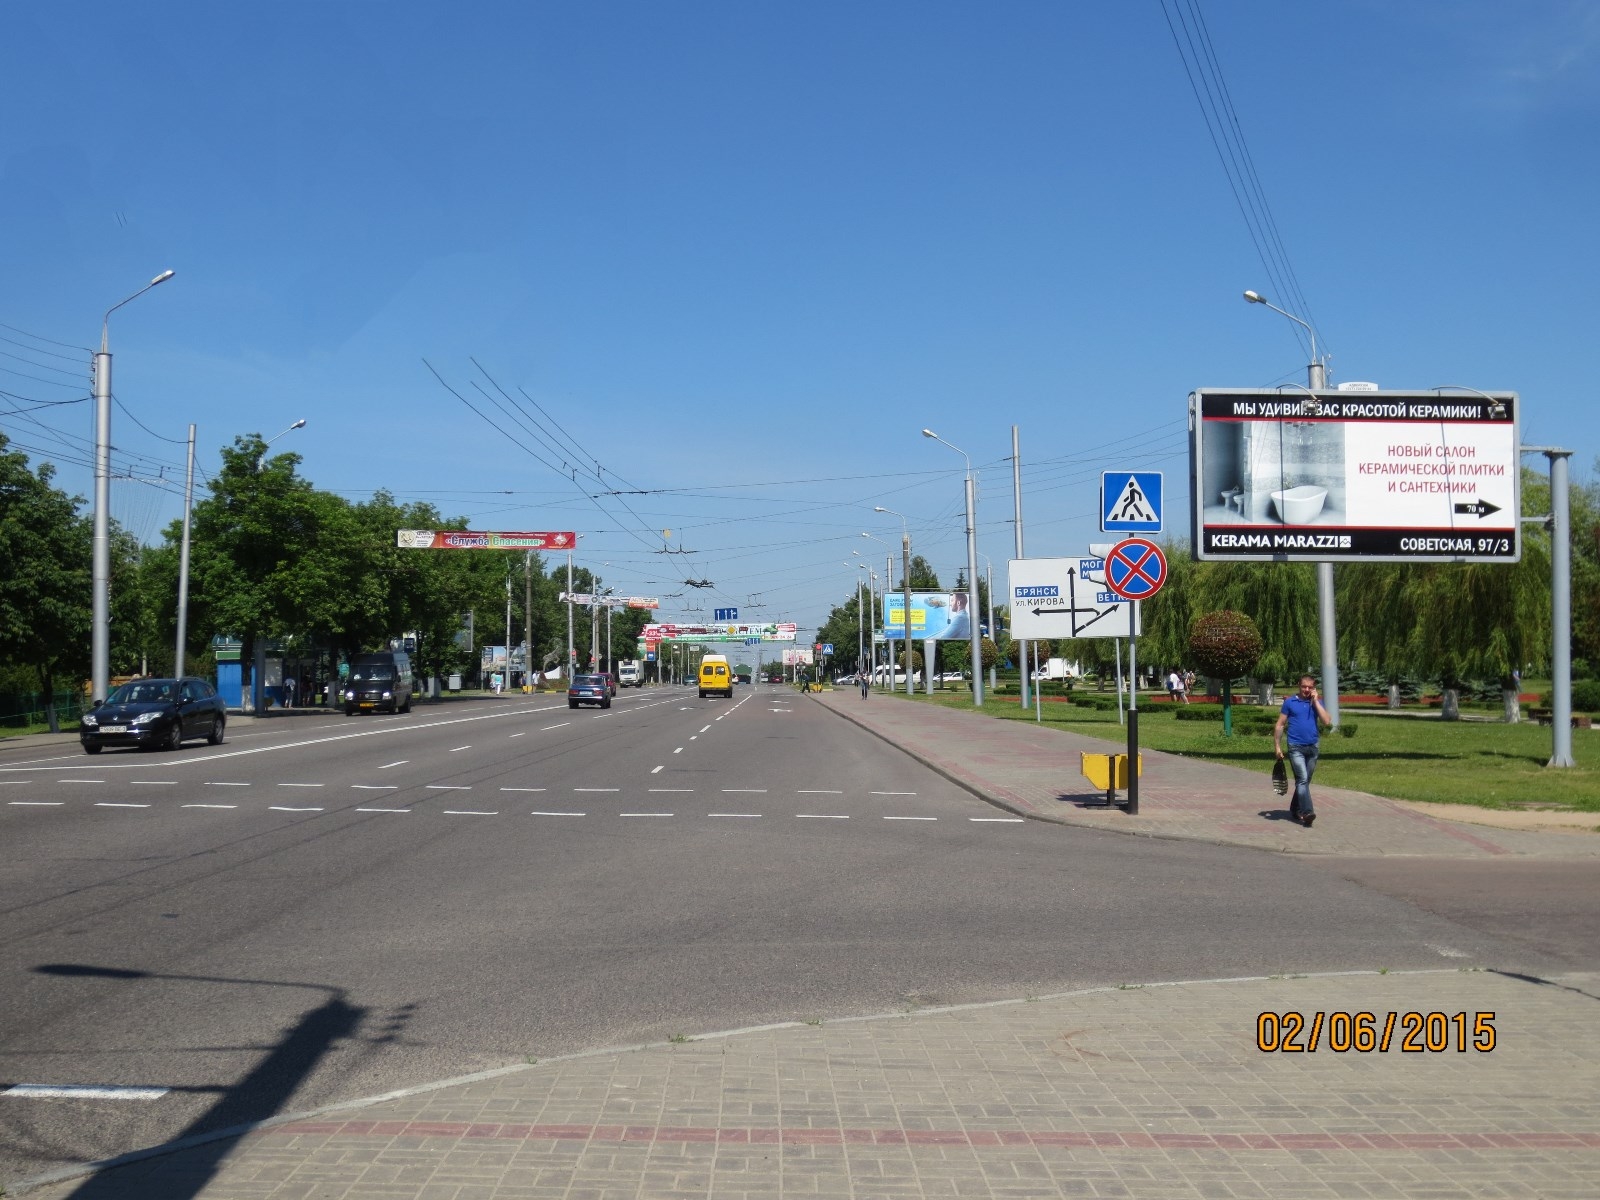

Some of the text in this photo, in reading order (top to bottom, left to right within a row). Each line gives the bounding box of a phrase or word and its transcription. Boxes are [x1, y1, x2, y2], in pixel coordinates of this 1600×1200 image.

[1233, 402, 1256, 415] МЫ
[1342, 402, 1406, 417] КРАСОТОЙ
[1409, 404, 1481, 418] КЕРАМИКИ!
[1388, 443, 1476, 458] НОВЫЙ САЛОН
[1359, 461, 1505, 476] КЕРАМИЧЕСКОЙ ПЛИТКИ
[1388, 481, 1476, 494] И САНТЕХНИКИ
[1466, 505, 1476, 513] 70
[1211, 534, 1338, 548] KERAMA MARAZZI
[1400, 537, 1509, 554] СОВЕТСКАЯ, 97/3
[1016, 587, 1057, 596] БРЯНСК
